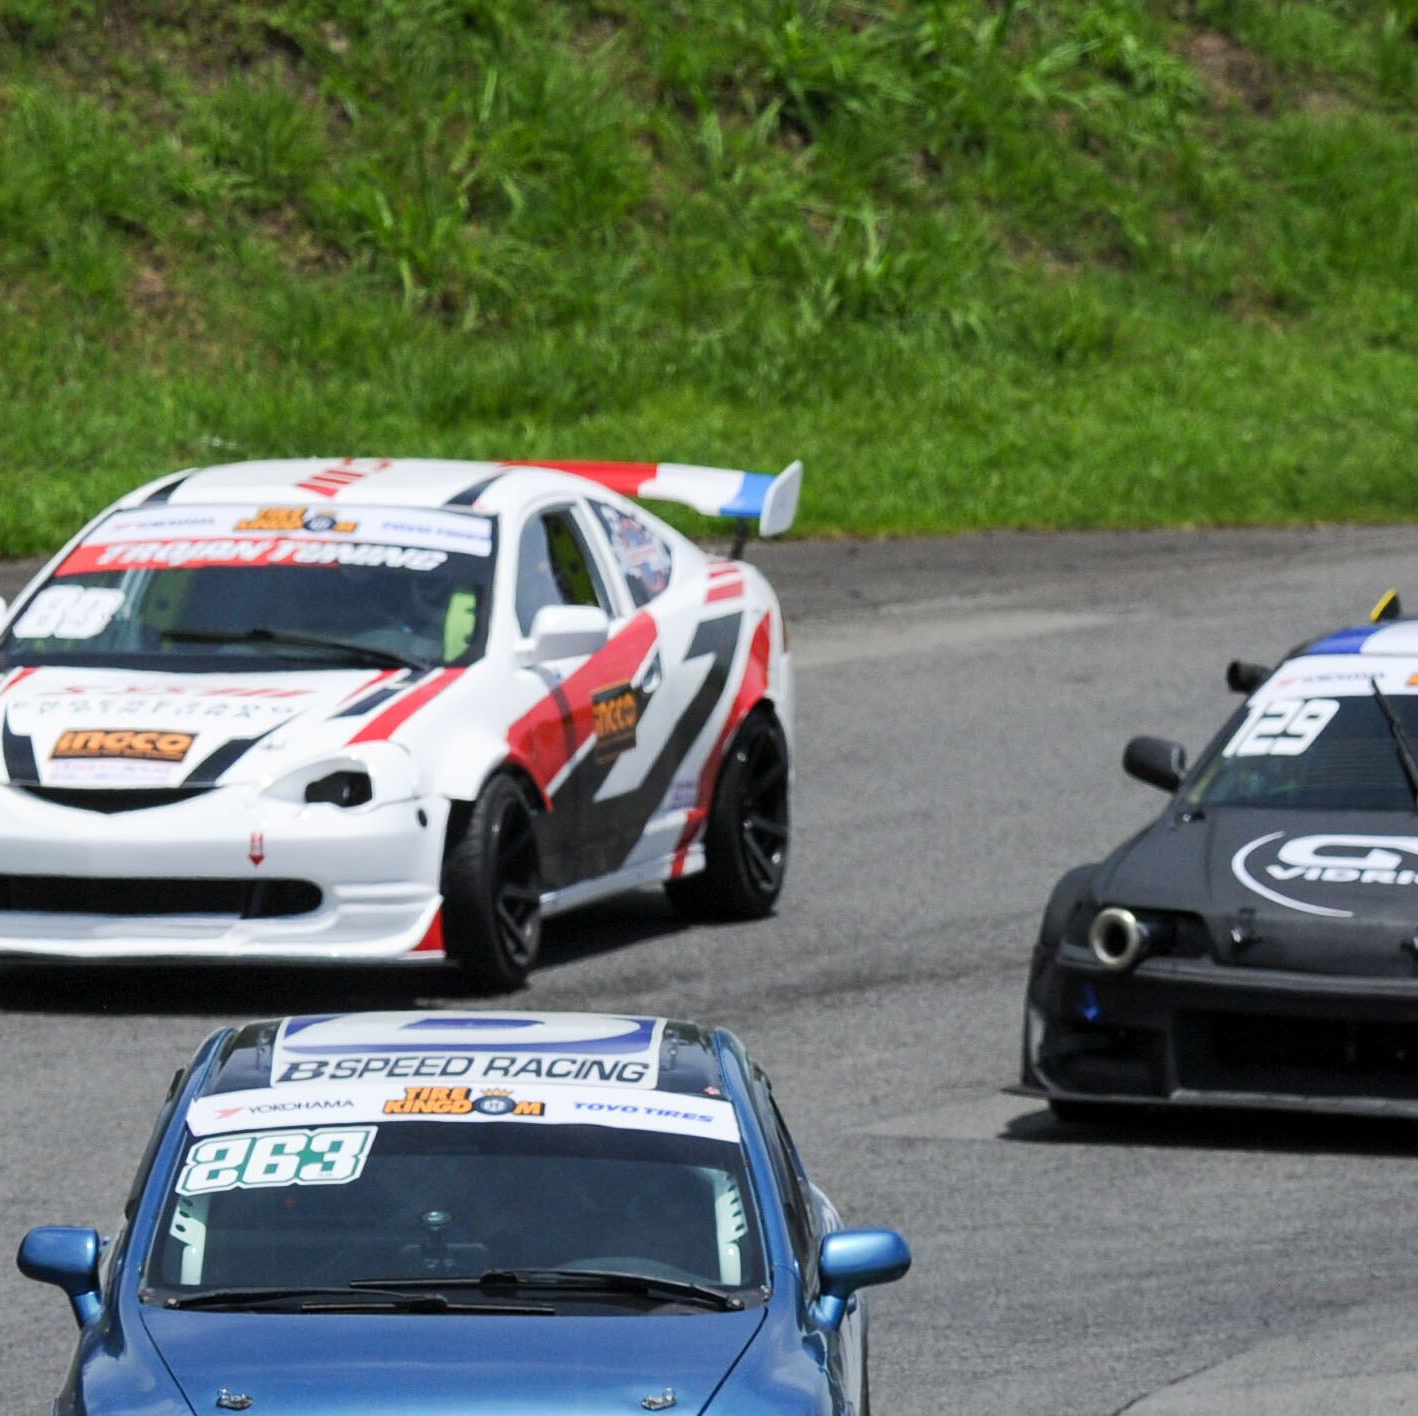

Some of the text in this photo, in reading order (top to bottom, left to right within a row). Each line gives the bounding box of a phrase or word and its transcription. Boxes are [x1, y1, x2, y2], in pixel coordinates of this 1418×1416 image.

[1222, 699, 1340, 757] 129
[482, 1057, 649, 1084] RACING
[403, 1087, 471, 1101] TIRE
[248, 1099, 355, 1115] YOKOHAMA
[573, 1102, 639, 1115] TOYO
[644, 1106, 716, 1124] TIRES
[179, 1128, 377, 1195] 263
